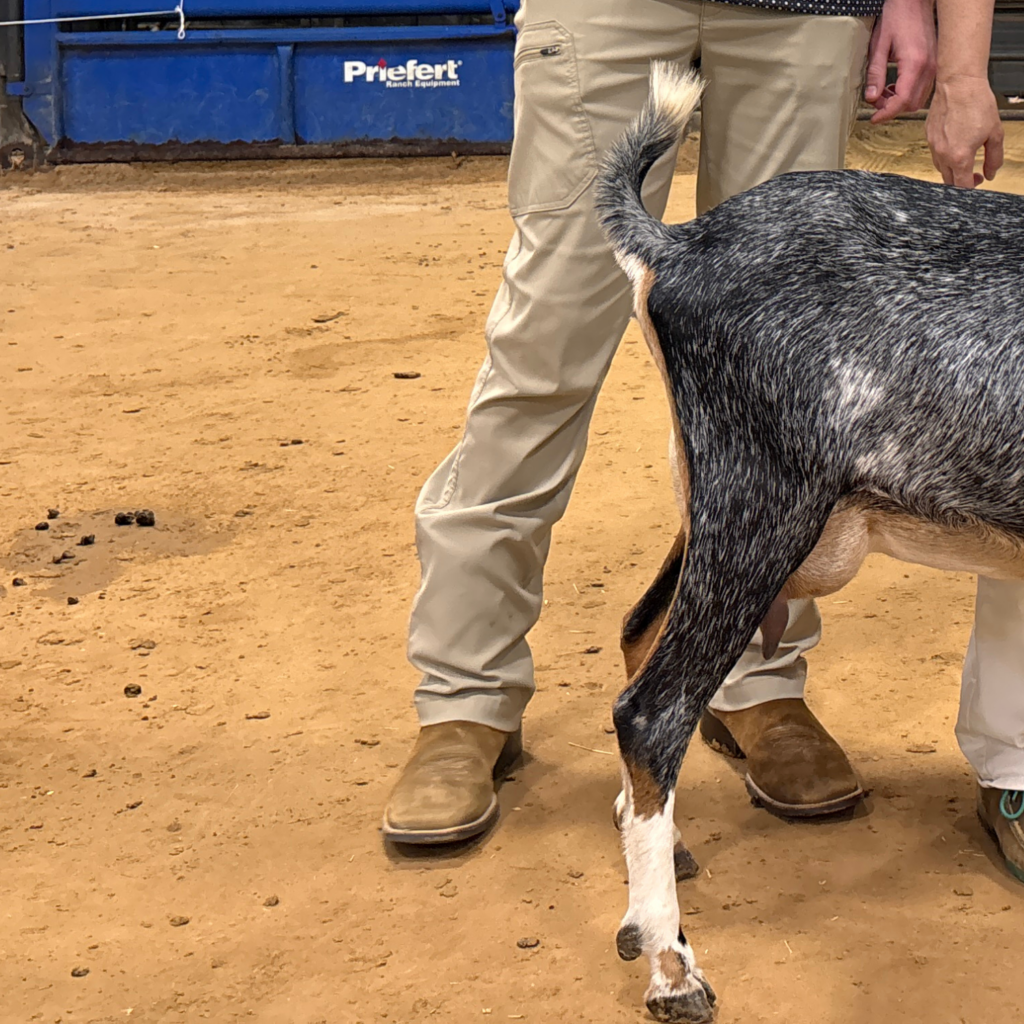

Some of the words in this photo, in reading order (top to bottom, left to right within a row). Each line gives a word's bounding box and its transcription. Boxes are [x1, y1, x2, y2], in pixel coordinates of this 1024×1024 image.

[344, 58, 459, 82] Priefert
[386, 79, 413, 88] Ranch
[415, 78, 460, 88] Equipment
